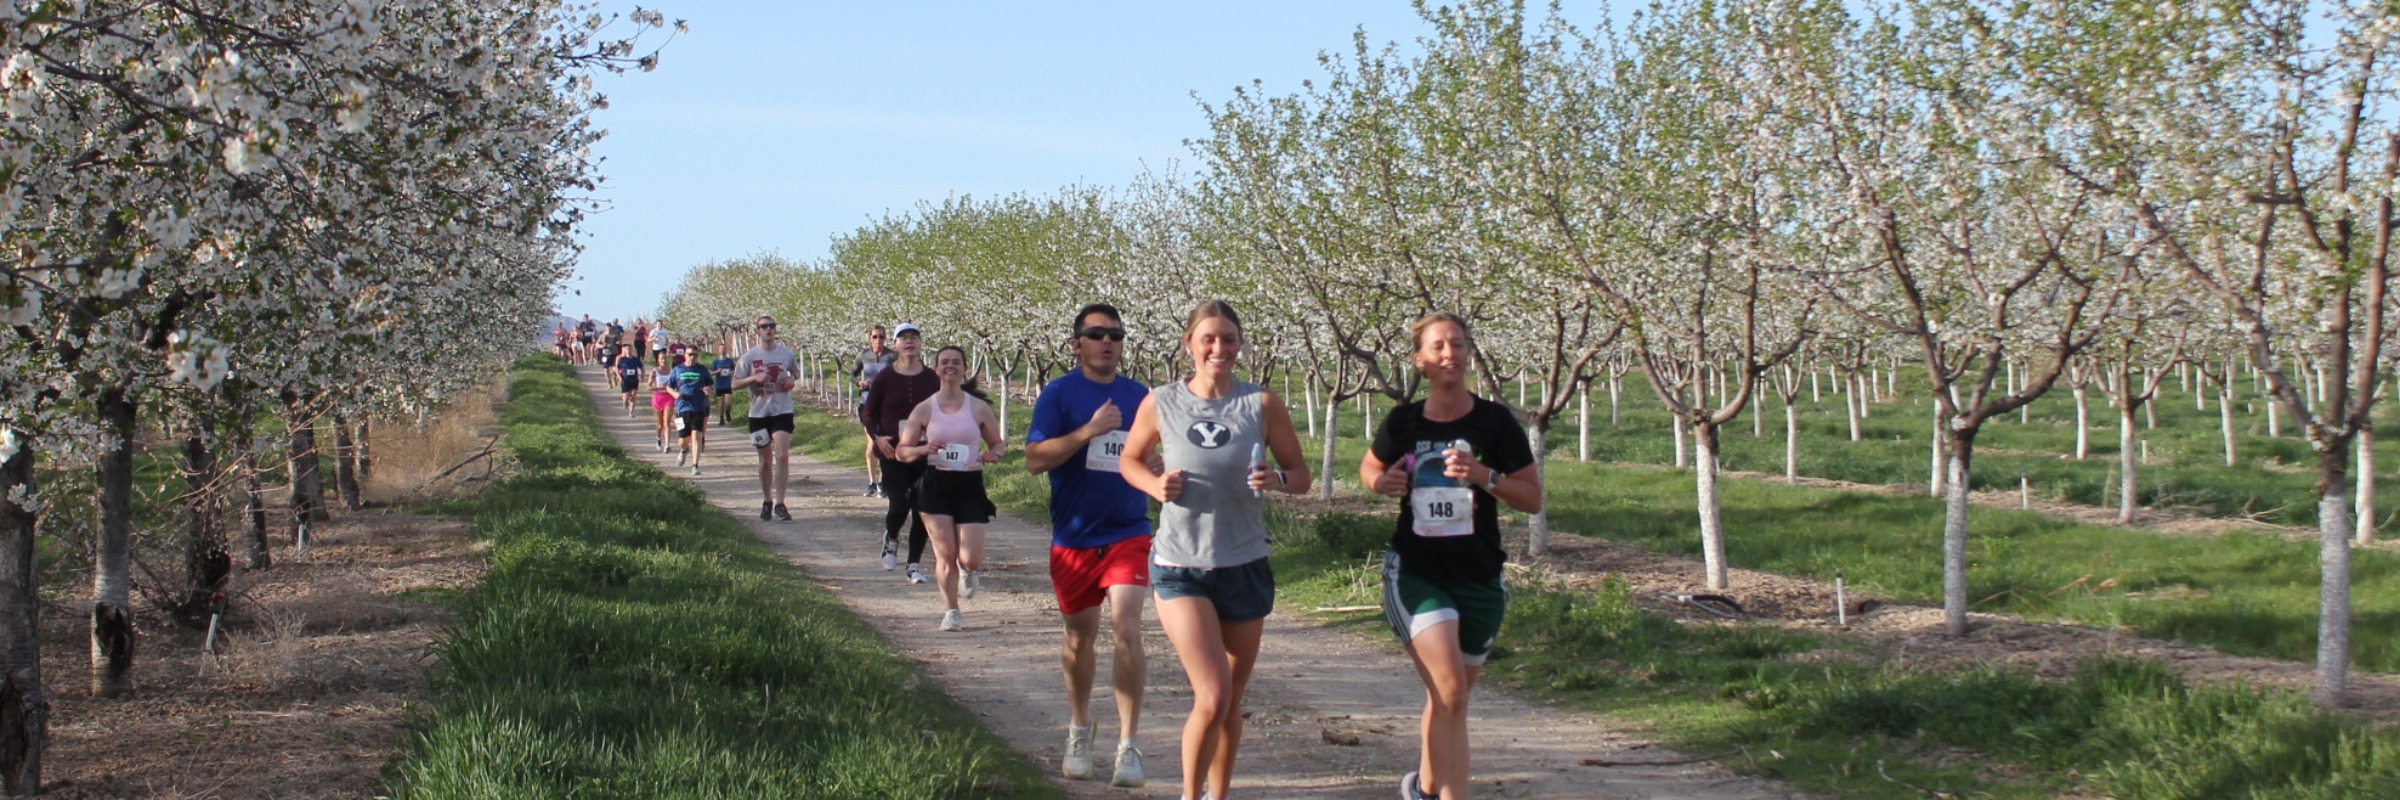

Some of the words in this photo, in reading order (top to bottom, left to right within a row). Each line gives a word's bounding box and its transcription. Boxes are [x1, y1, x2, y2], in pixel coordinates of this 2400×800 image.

[1192, 422, 1227, 447] Y
[945, 451, 958, 461] 147
[1428, 501, 1454, 518] 148
